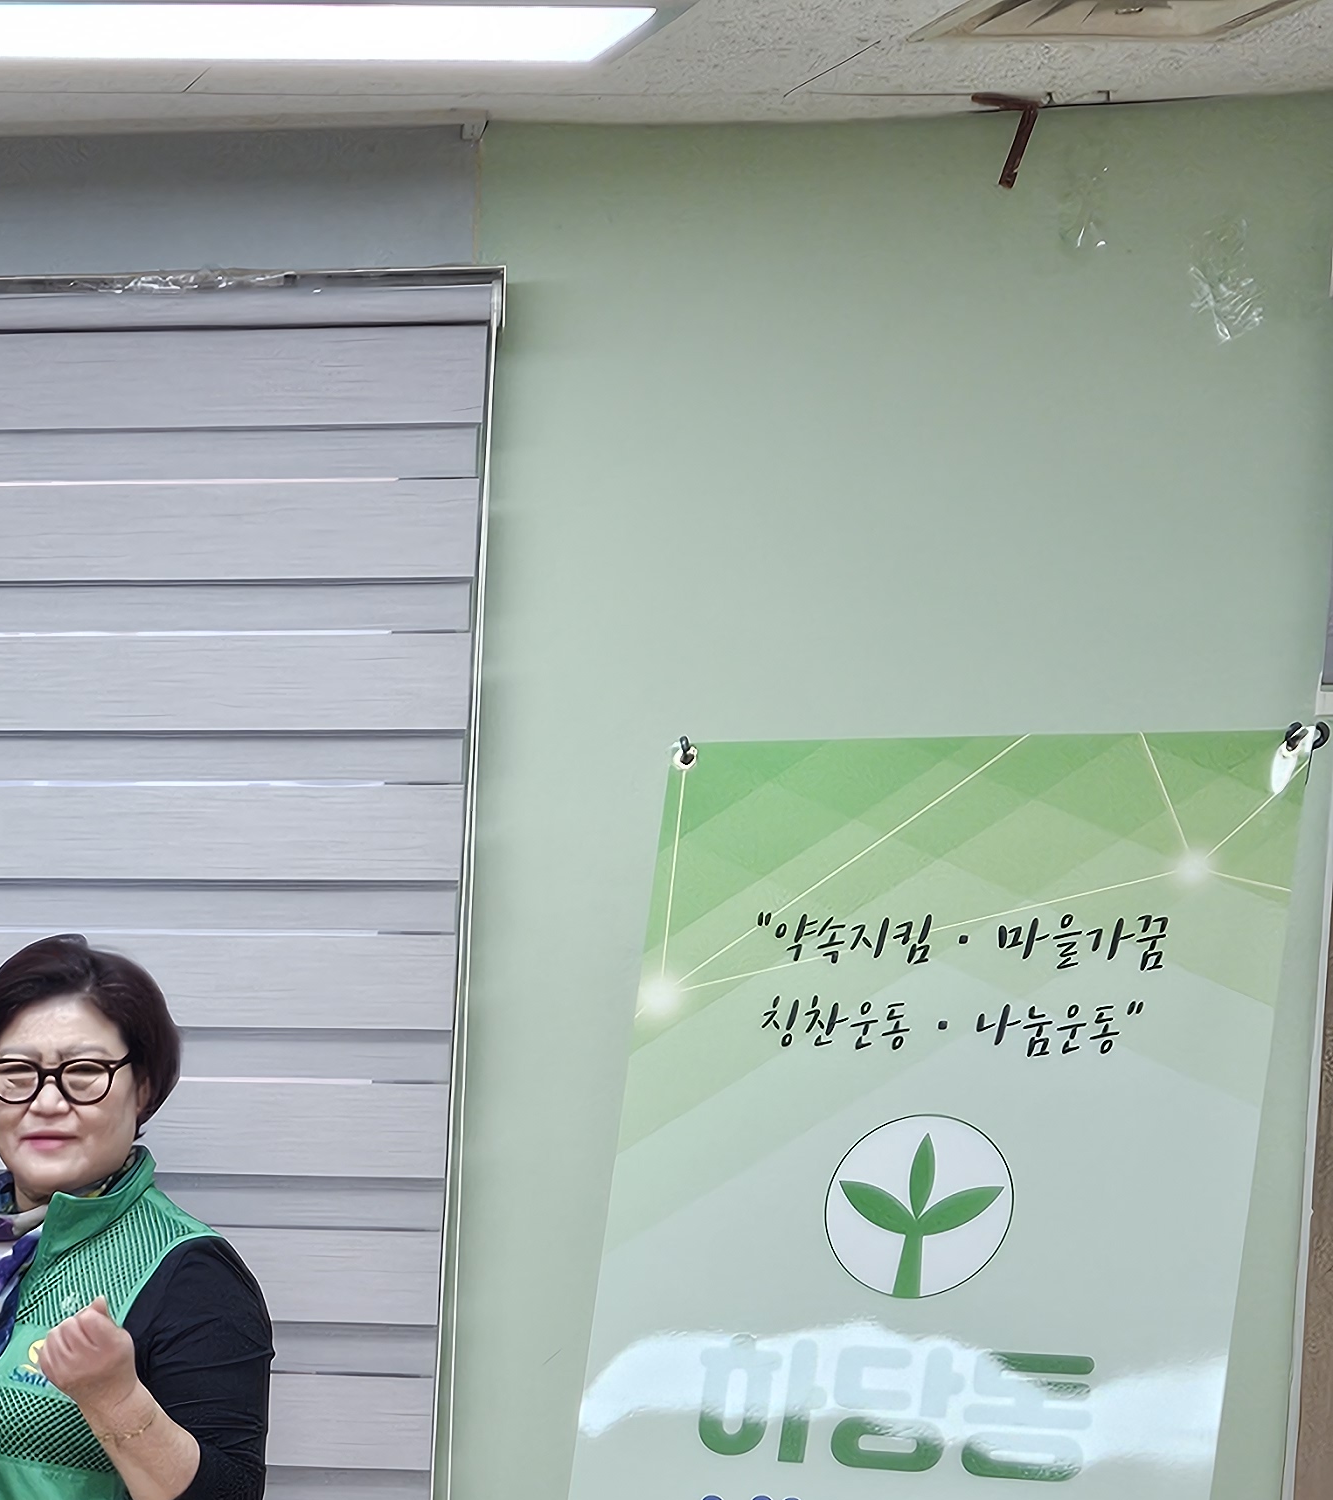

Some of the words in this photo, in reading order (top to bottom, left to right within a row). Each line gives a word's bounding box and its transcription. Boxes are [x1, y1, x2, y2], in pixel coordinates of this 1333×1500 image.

[997, 913, 1170, 971] 마을가꿈
[760, 995, 911, 1051] 칭찬운동
[697, 1334, 1095, 1482] 하당동
